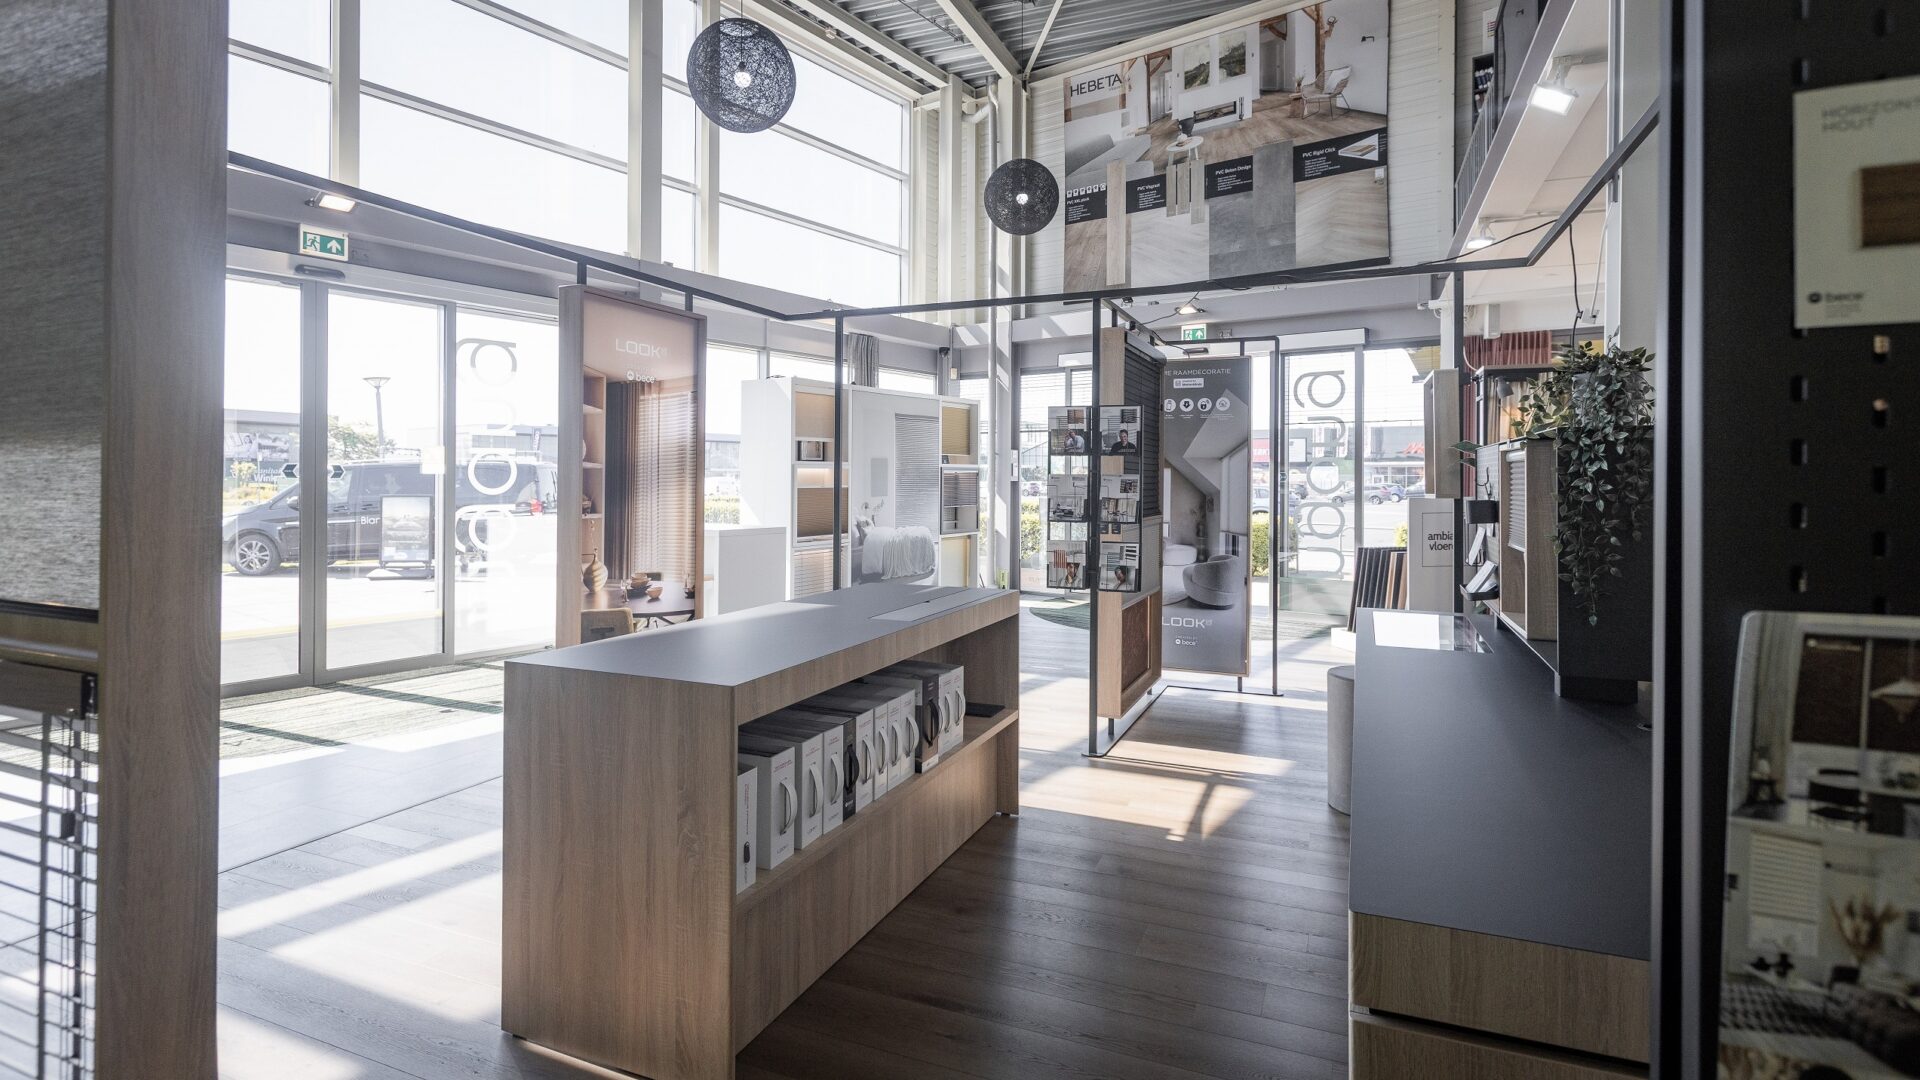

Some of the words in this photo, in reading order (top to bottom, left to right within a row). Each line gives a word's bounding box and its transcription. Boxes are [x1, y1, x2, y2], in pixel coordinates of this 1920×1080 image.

[1070, 73, 1122, 97] HEBETA
[1822, 118, 1876, 132] HOUT
[1173, 368, 1232, 376] RAAMDECORATIE
